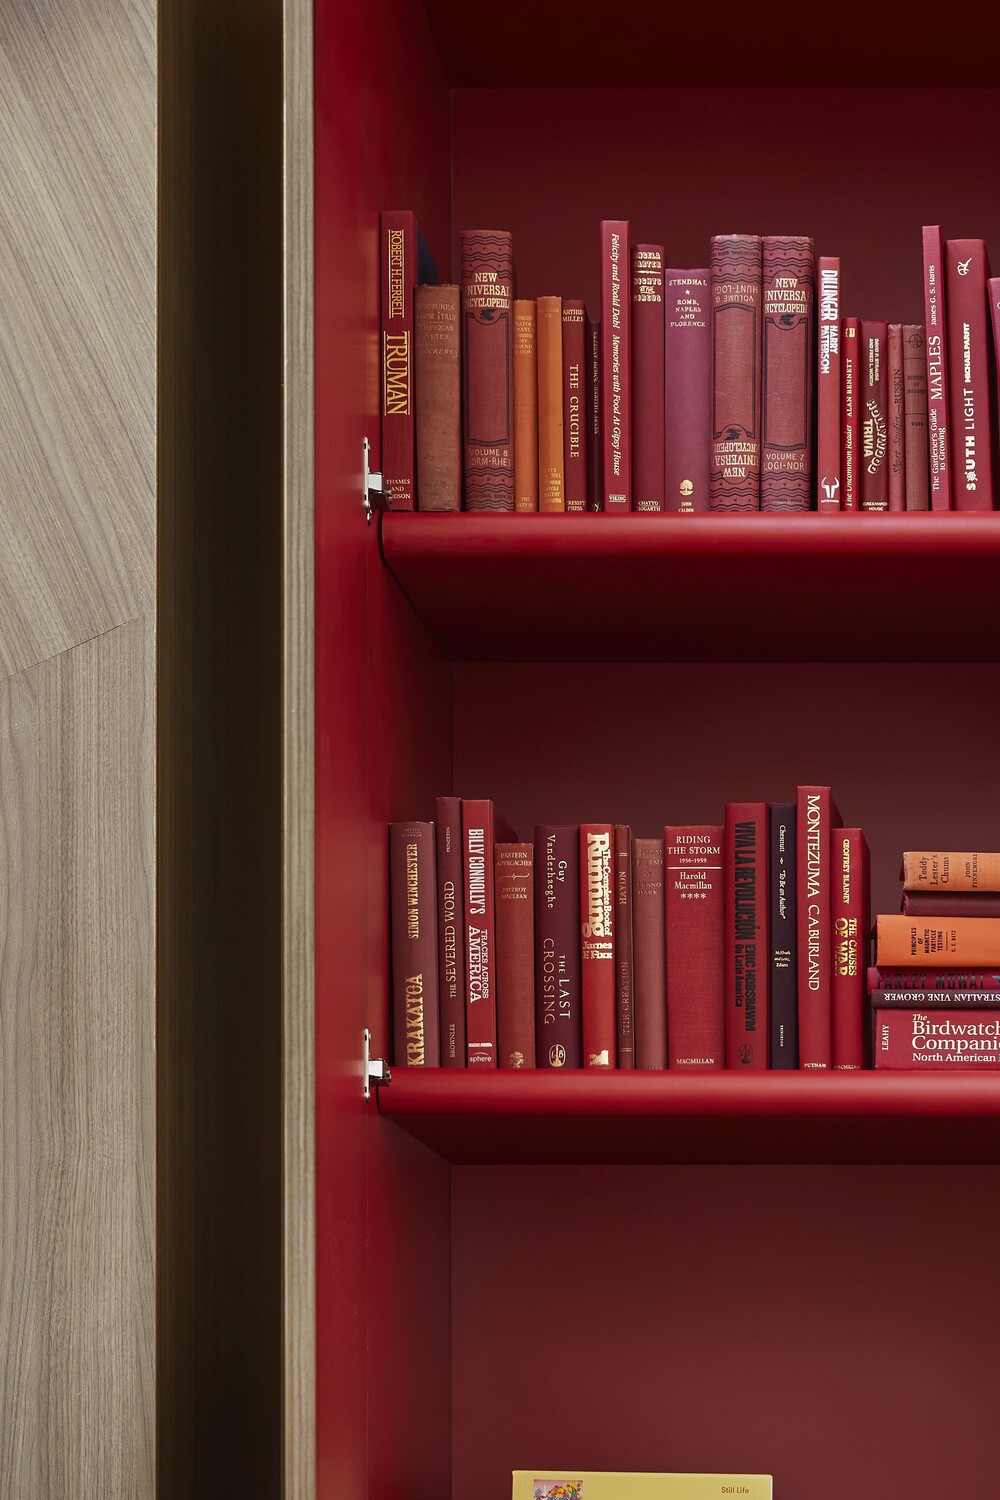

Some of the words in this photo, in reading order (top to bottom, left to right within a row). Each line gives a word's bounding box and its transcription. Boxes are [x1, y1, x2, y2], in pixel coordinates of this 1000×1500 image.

[391, 230, 402, 267] ROBERT
[609, 233, 620, 263] Felicity
[474, 273, 498, 282] NEW
[611, 264, 620, 281] and
[775, 278, 798, 288] NEW
[391, 279, 403, 318] FERRELL
[611, 283, 620, 307] Roald
[821, 269, 838, 321] DILLINGER
[612, 308, 621, 328] Dahl
[612, 334, 621, 372] Memories
[821, 325, 829, 374] PATTERSON
[829, 325, 838, 354] HARRY
[386, 331, 408, 415] TRUMAN
[569, 364, 579, 388] THE
[929, 335, 942, 400] MAPLES
[613, 374, 621, 392] with
[613, 394, 621, 414] Food
[963, 388, 975, 429] LIGHT
[569, 396, 579, 458] CRUCIBLE
[611, 426, 621, 449] Gipsy
[863, 419, 873, 457] TRIVIA
[866, 399, 887, 474] HOLLYWOOD
[613, 450, 621, 475] House
[723, 467, 745, 477] NEW
[845, 492, 853, 507] The
[468, 829, 484, 854] BILLY
[676, 836, 711, 844] RIDING
[734, 821, 755, 848] VIVA
[807, 795, 820, 898] MONTEZUMA
[734, 850, 755, 865] LA
[918, 856, 929, 881] Teddy
[930, 854, 938, 885] Lester's
[941, 856, 949, 884] Chums
[406, 843, 418, 906] WINCHESTER
[544, 834, 556, 909] Vanderhaeghe
[556, 860, 567, 883] Guy
[582, 832, 610, 938] Running
[674, 881, 712, 889] Macmillan
[679, 872, 706, 880] Harold
[468, 857, 486, 915] CONNOLLY'S
[618, 871, 627, 905] HAYDN
[444, 881, 455, 923] WORD
[408, 908, 419, 939] SIMON
[835, 917, 849, 938] OF
[849, 918, 857, 936] THE
[445, 925, 456, 982] SEVERED
[583, 941, 612, 949] James
[735, 944, 742, 954] On
[745, 944, 756, 968] ERIC
[835, 940, 849, 976] WAR
[849, 940, 857, 976] CAUSES
[469, 925, 481, 1003] AMERICA
[735, 955, 745, 975] Latin
[449, 984, 457, 998] THE
[481, 965, 489, 999] ACROSS
[543, 938, 555, 1024] CROSSING
[621, 961, 630, 1011] CREATION
[735, 977, 745, 1008] America
[878, 973, 928, 990] FARLEY
[935, 973, 985, 990] MOWAT
[559, 979, 571, 1019] LAST
[745, 969, 756, 1031] HOBSBAWM
[884, 993, 925, 1001] GROWER
[927, 993, 951, 1001] VINE
[405, 973, 424, 1067] KRAKATOA
[622, 1013, 630, 1035] THE
[912, 1013, 928, 1021] The
[881, 1025, 889, 1051] LEAHY
[912, 1052, 943, 1062] North
[945, 1053, 996, 1062] American
[721, 1486, 735, 1494] Still
[736, 1486, 750, 1494] Life
